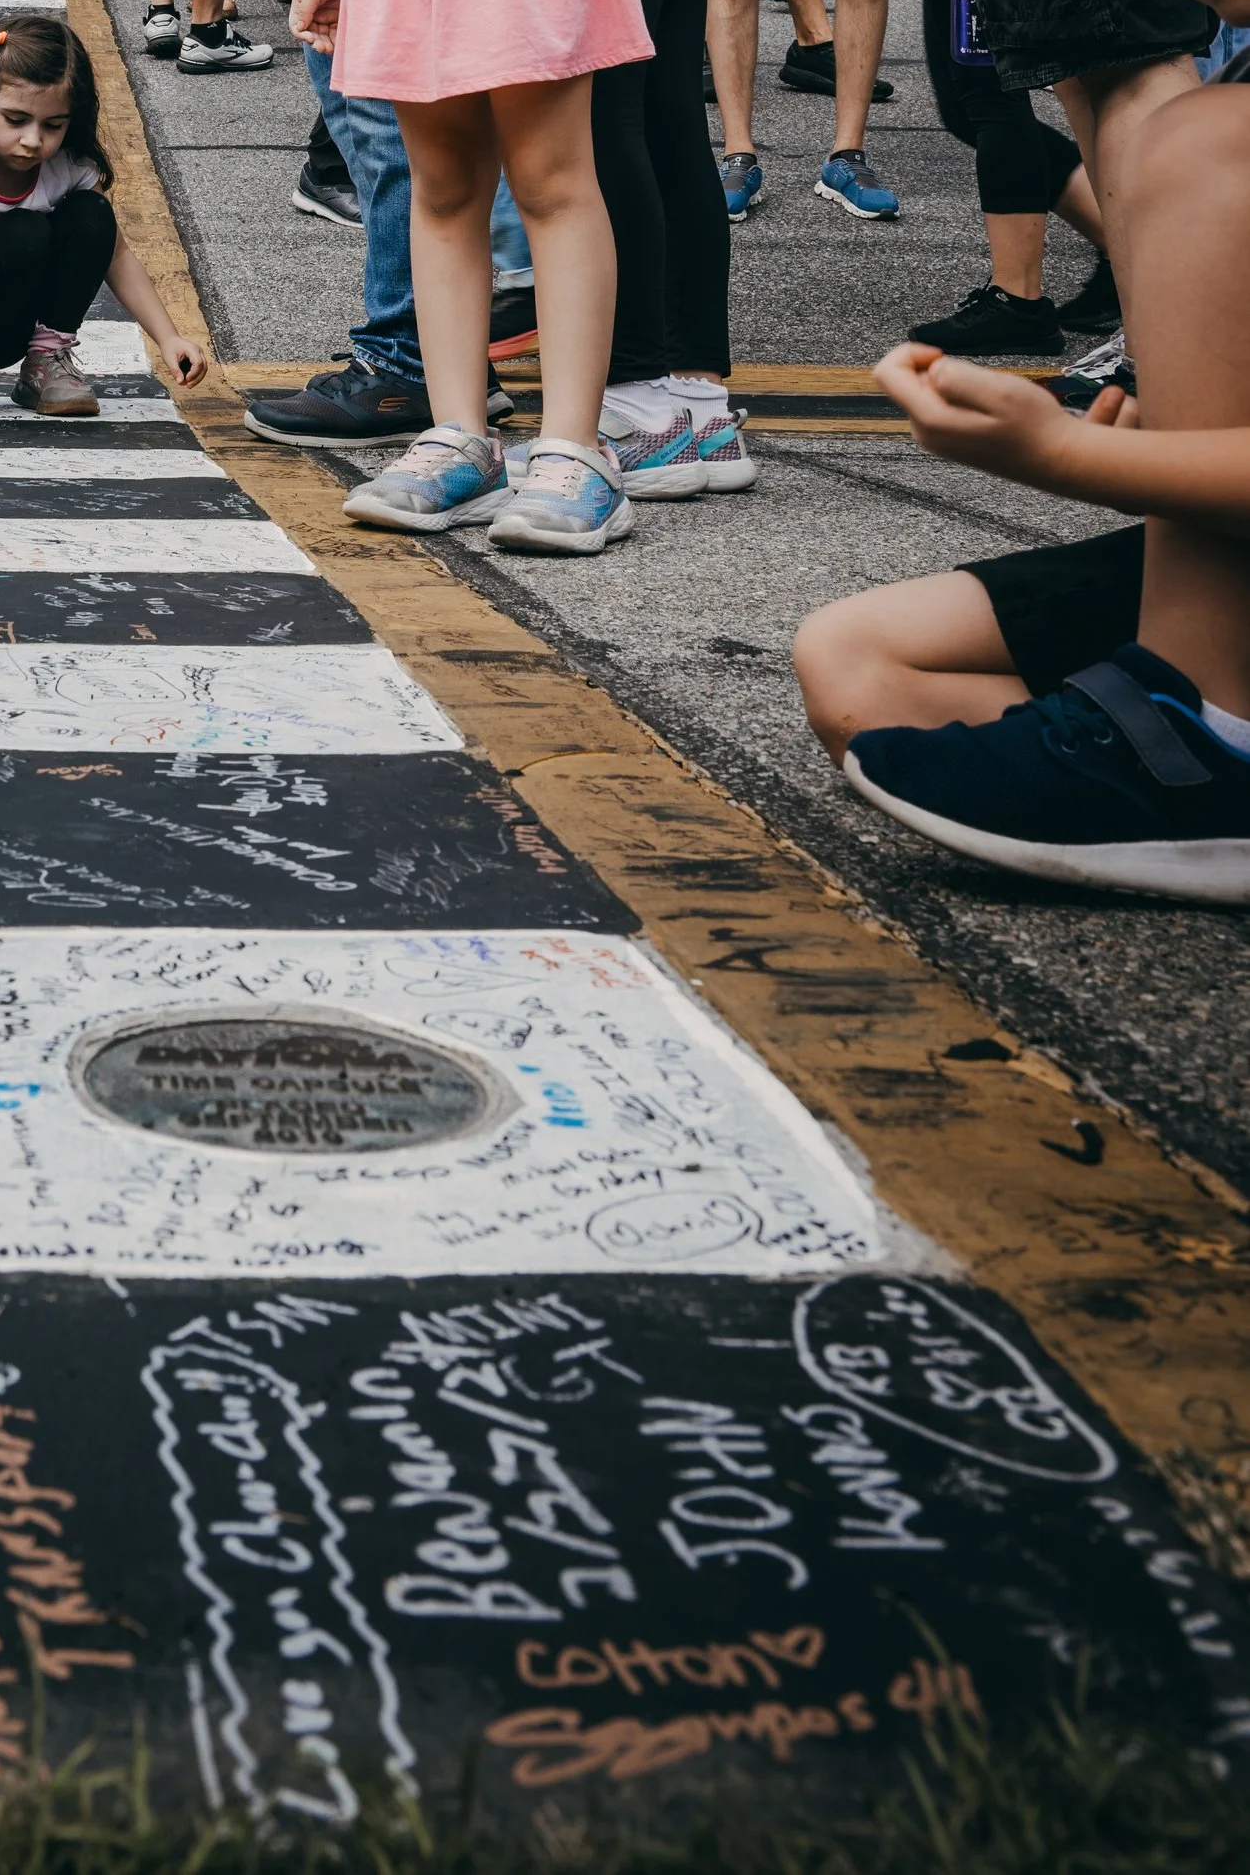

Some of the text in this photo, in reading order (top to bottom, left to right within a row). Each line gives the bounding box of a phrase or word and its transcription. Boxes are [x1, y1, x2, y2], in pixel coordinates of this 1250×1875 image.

[136, 1038, 417, 1070] DAYTONA
[145, 1074, 423, 1095] TIME CAPSULE
[638, 1395, 810, 1591] JOHN
